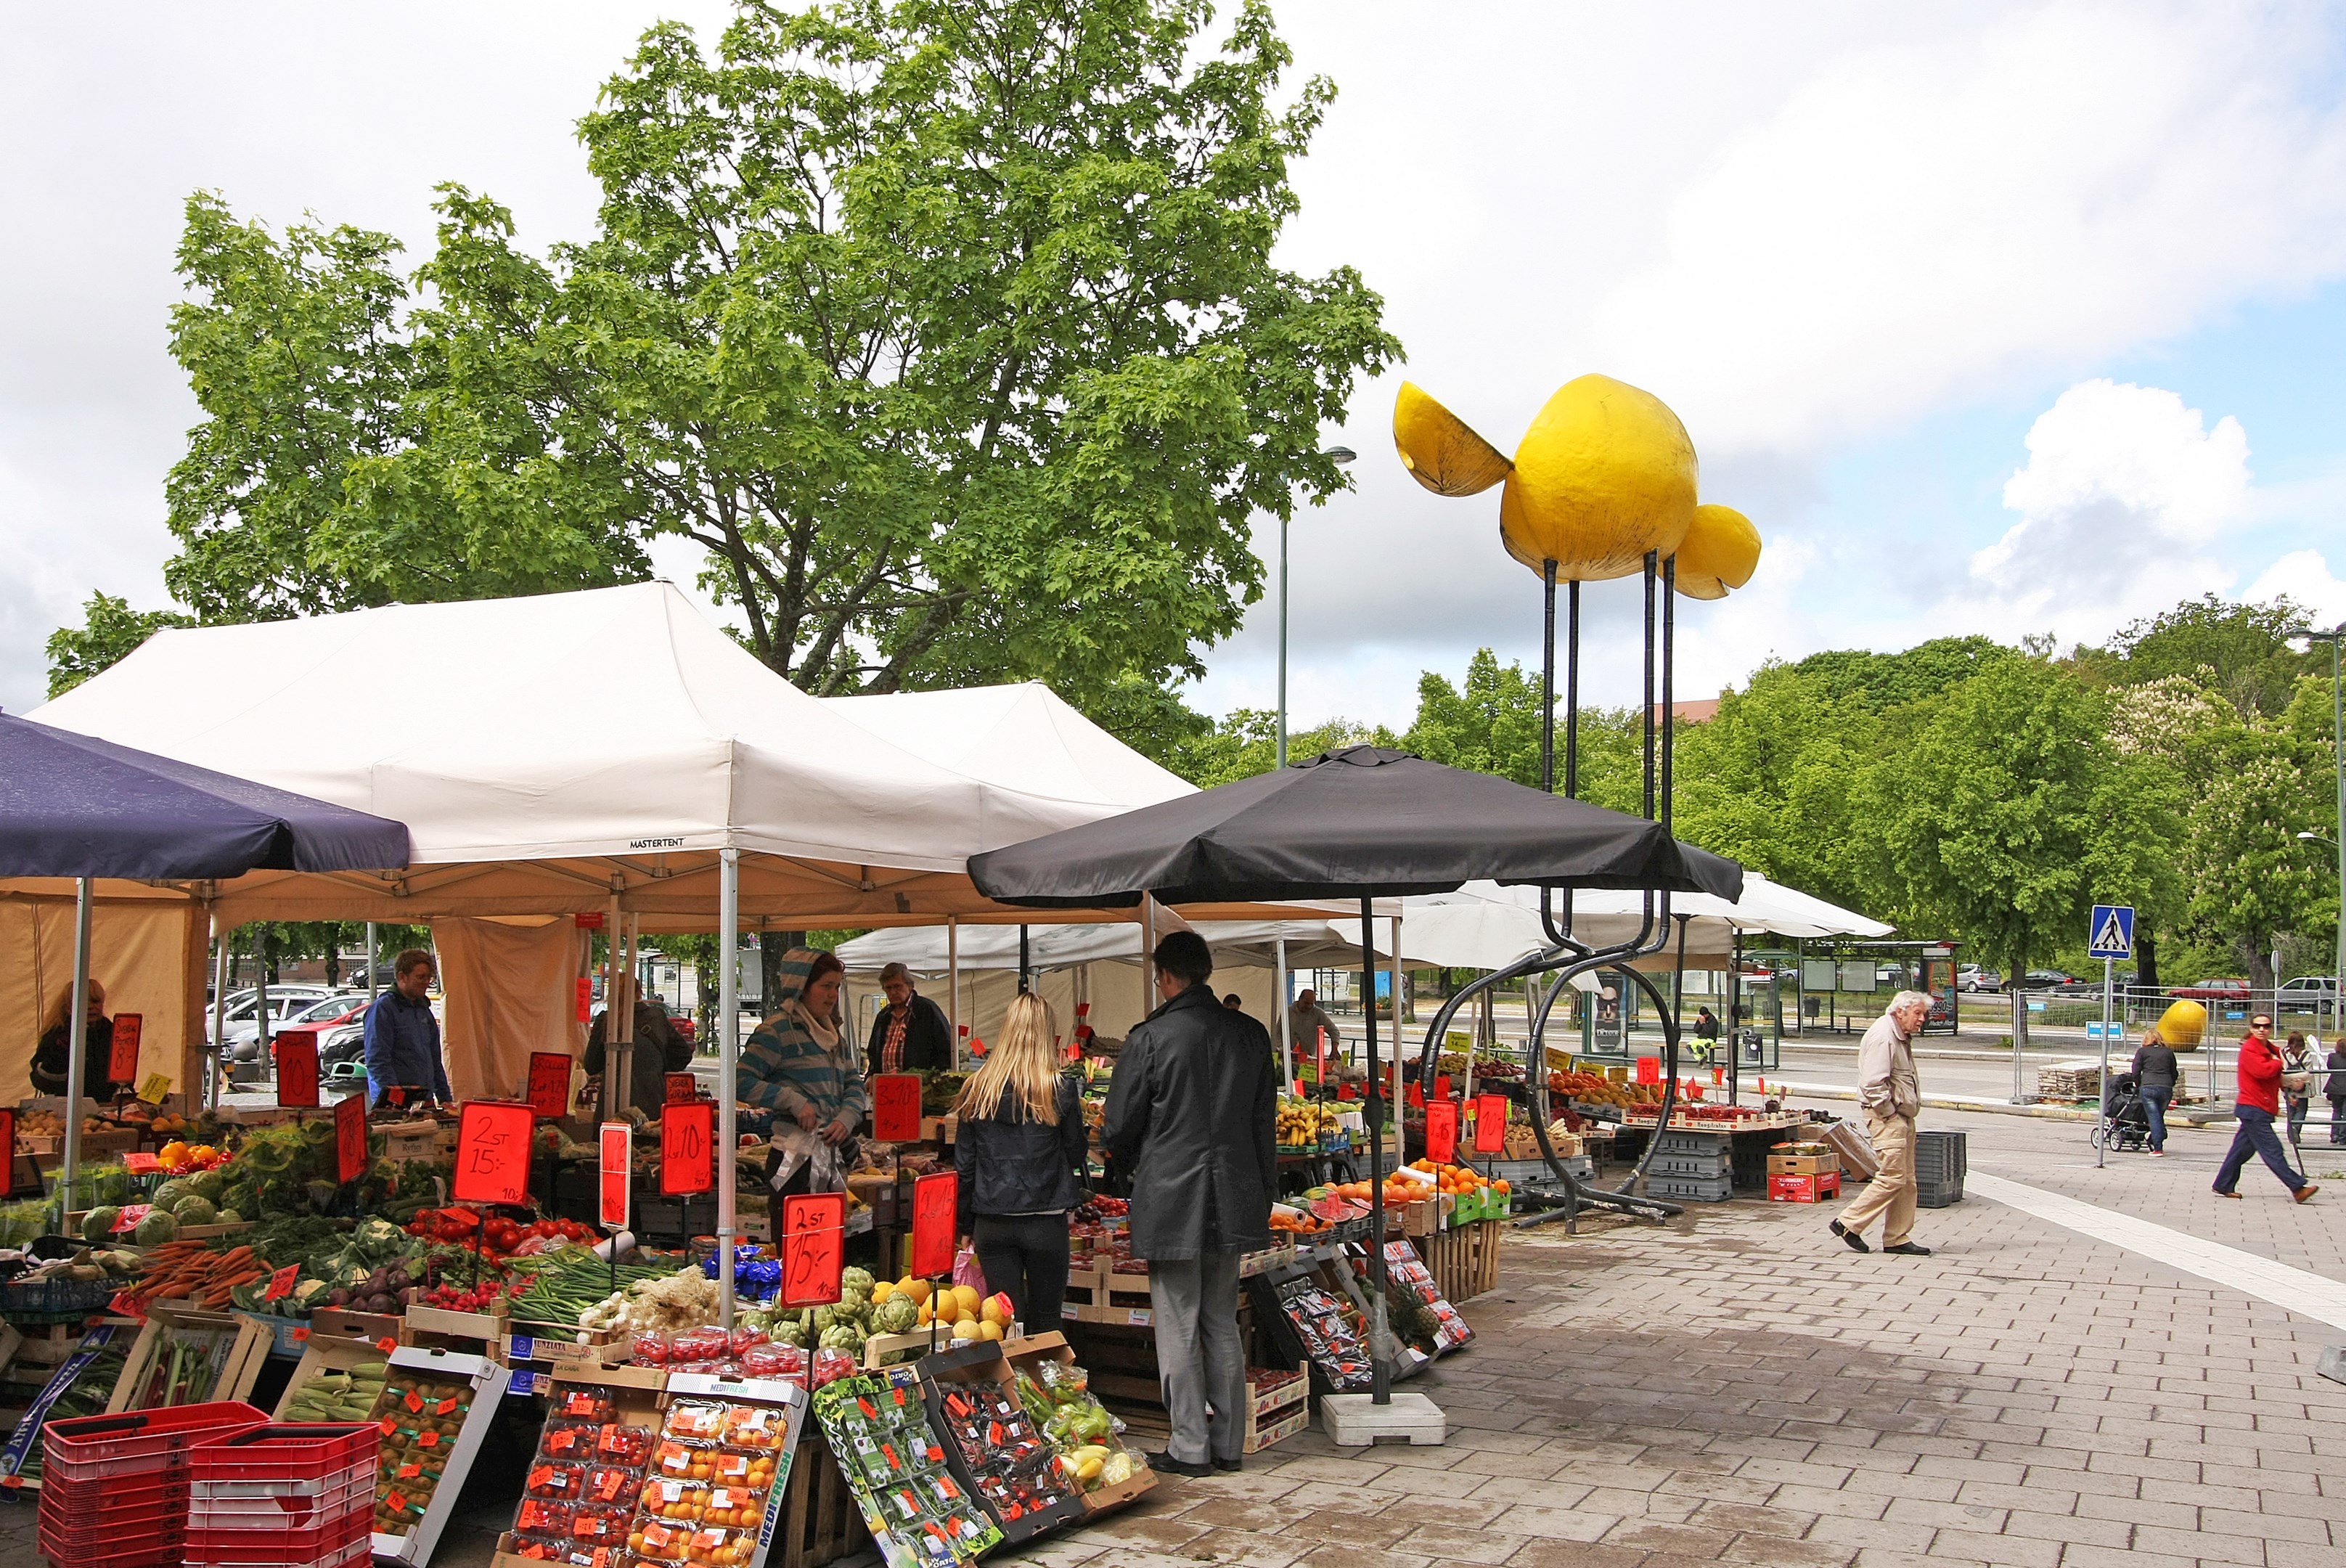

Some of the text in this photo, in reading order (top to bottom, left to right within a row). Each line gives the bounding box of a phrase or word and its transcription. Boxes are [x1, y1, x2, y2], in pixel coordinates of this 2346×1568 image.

[629, 837, 684, 849] MASTERTENT
[470, 1148, 505, 1175] 15:-
[710, 1383, 749, 1394] MEDIFRESH
[664, 1447, 678, 1455] 20:-
[730, 1490, 745, 1499] 20:-
[759, 1451, 792, 1548] MEDIFRESH
[697, 1535, 711, 1544] 20:-
